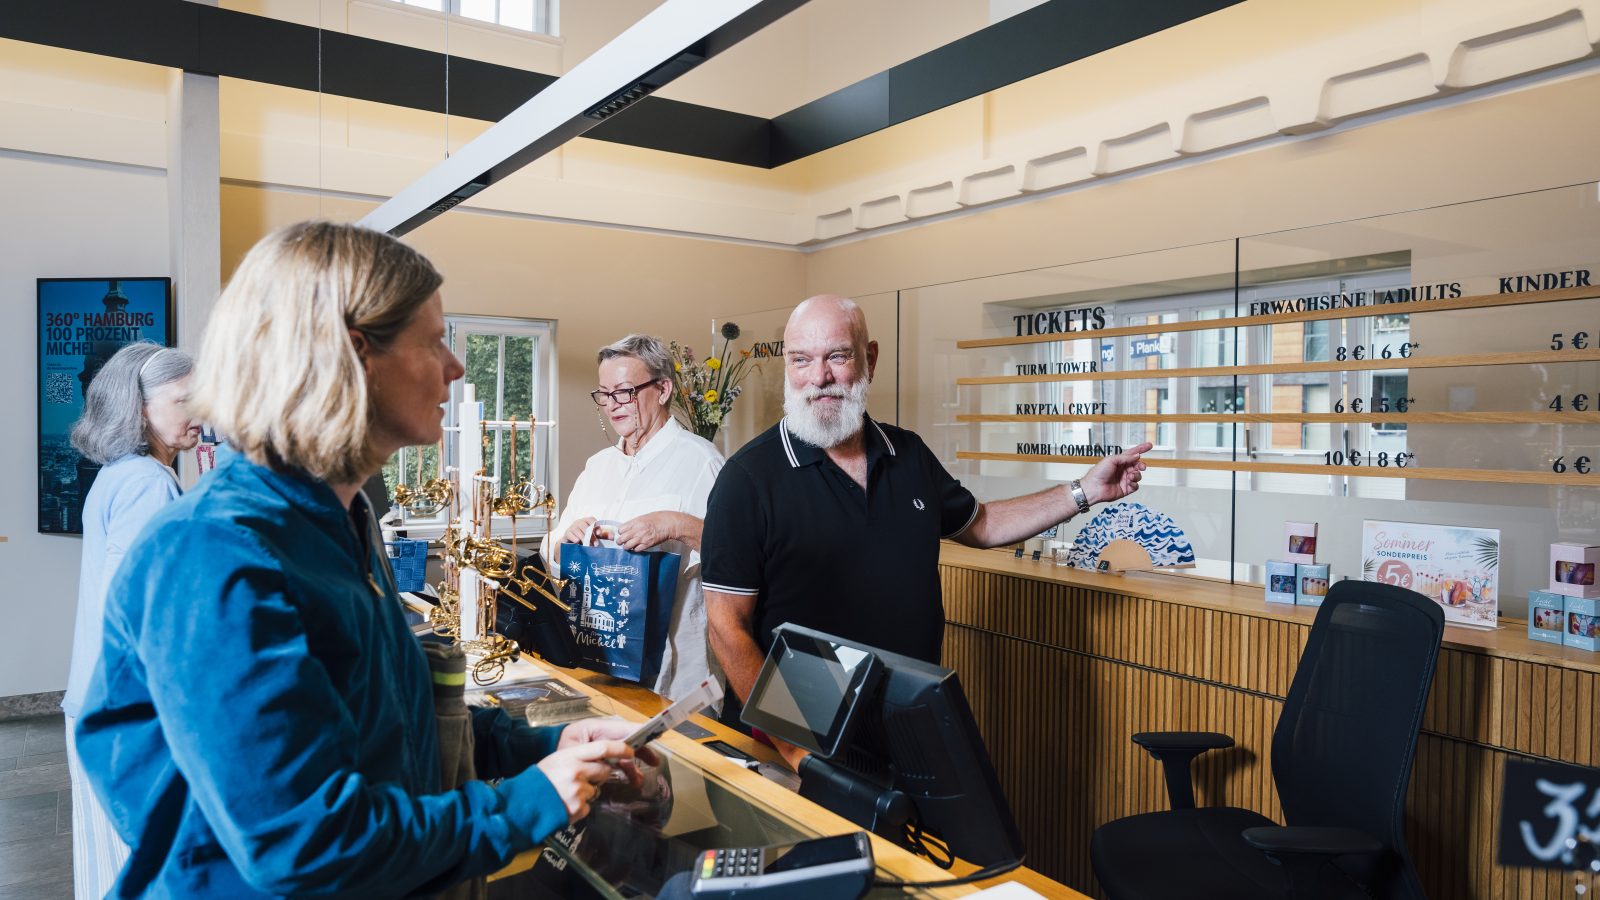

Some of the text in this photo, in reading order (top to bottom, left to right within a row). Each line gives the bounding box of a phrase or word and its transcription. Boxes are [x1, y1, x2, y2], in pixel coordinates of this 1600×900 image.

[1499, 269, 1591, 294] KINDER
[1250, 282, 1462, 316] ERWACHSENE ADULTS
[84, 312, 154, 326] HAMBURG
[1013, 306, 1106, 336] TICKETS
[46, 327, 140, 341] 100 PROZENT
[46, 341, 97, 355] MICHEL
[1136, 340, 1160, 354] Plank
[1016, 361, 1098, 376] TURM TOWER
[1016, 402, 1107, 415] KRYPTA CRYPT
[1016, 442, 1123, 458] KOMBI COMBINED
[1373, 531, 1435, 551] Sommer
[1376, 550, 1428, 560] SONDERPREIS
[576, 631, 617, 648] Michel
